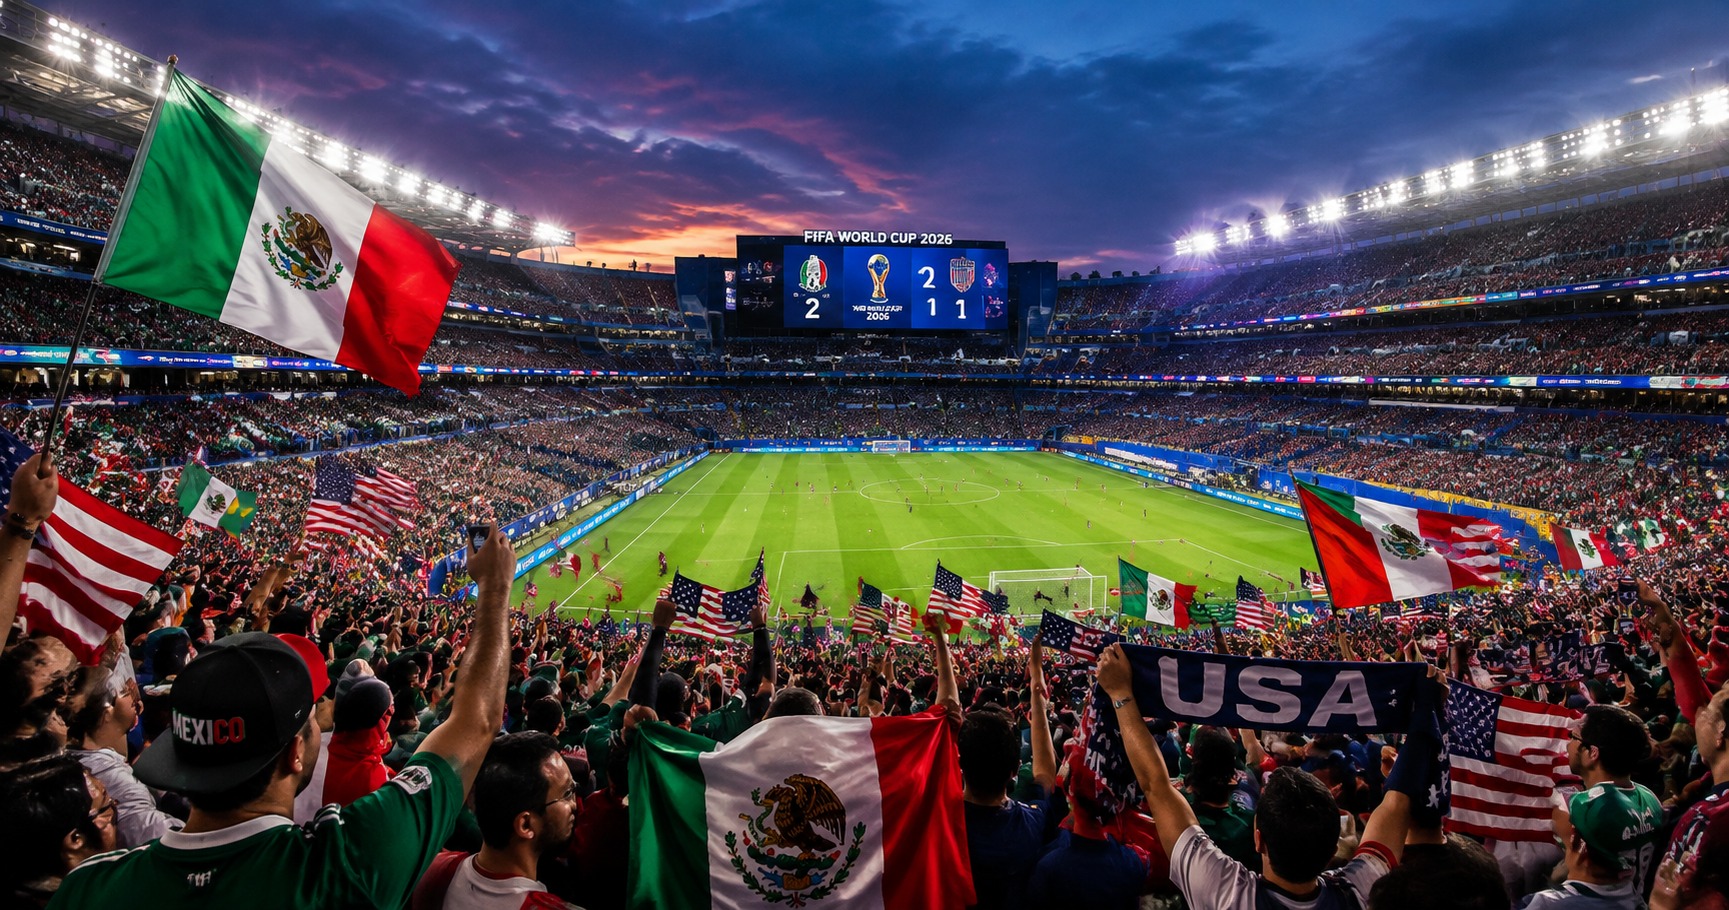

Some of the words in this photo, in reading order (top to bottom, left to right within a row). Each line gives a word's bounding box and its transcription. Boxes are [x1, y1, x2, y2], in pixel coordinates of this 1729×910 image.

[836, 230, 887, 244] WORLD
[890, 232, 917, 245] CUP
[920, 233, 953, 245] 2026
[917, 266, 936, 289] 2
[804, 297, 820, 319] 2
[927, 298, 936, 316] 1
[955, 300, 967, 319] 1
[1157, 655, 1378, 727] USA
[172, 708, 245, 745] MEXICO
